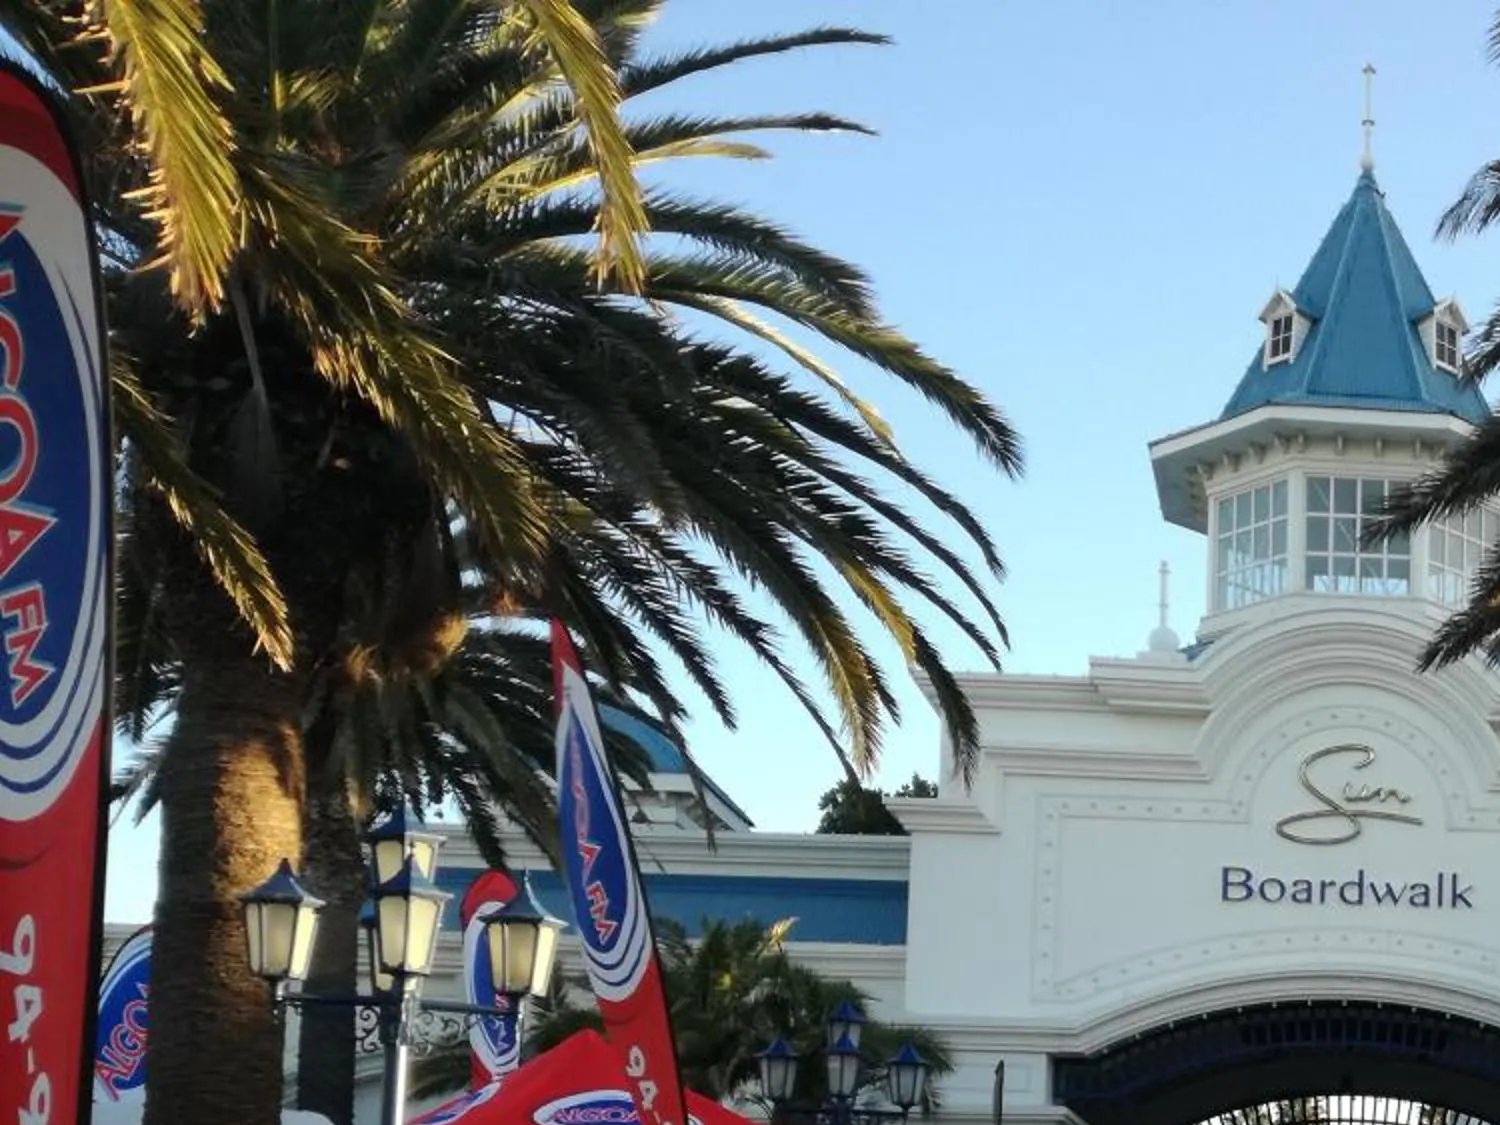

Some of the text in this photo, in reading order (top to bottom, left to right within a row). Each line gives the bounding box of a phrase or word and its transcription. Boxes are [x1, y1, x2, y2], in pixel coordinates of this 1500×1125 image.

[2, 581, 56, 710] FM
[1276, 743, 1424, 845] Sun
[1220, 865, 1474, 909] Boardwalk
[95, 981, 150, 1102] ALGO
